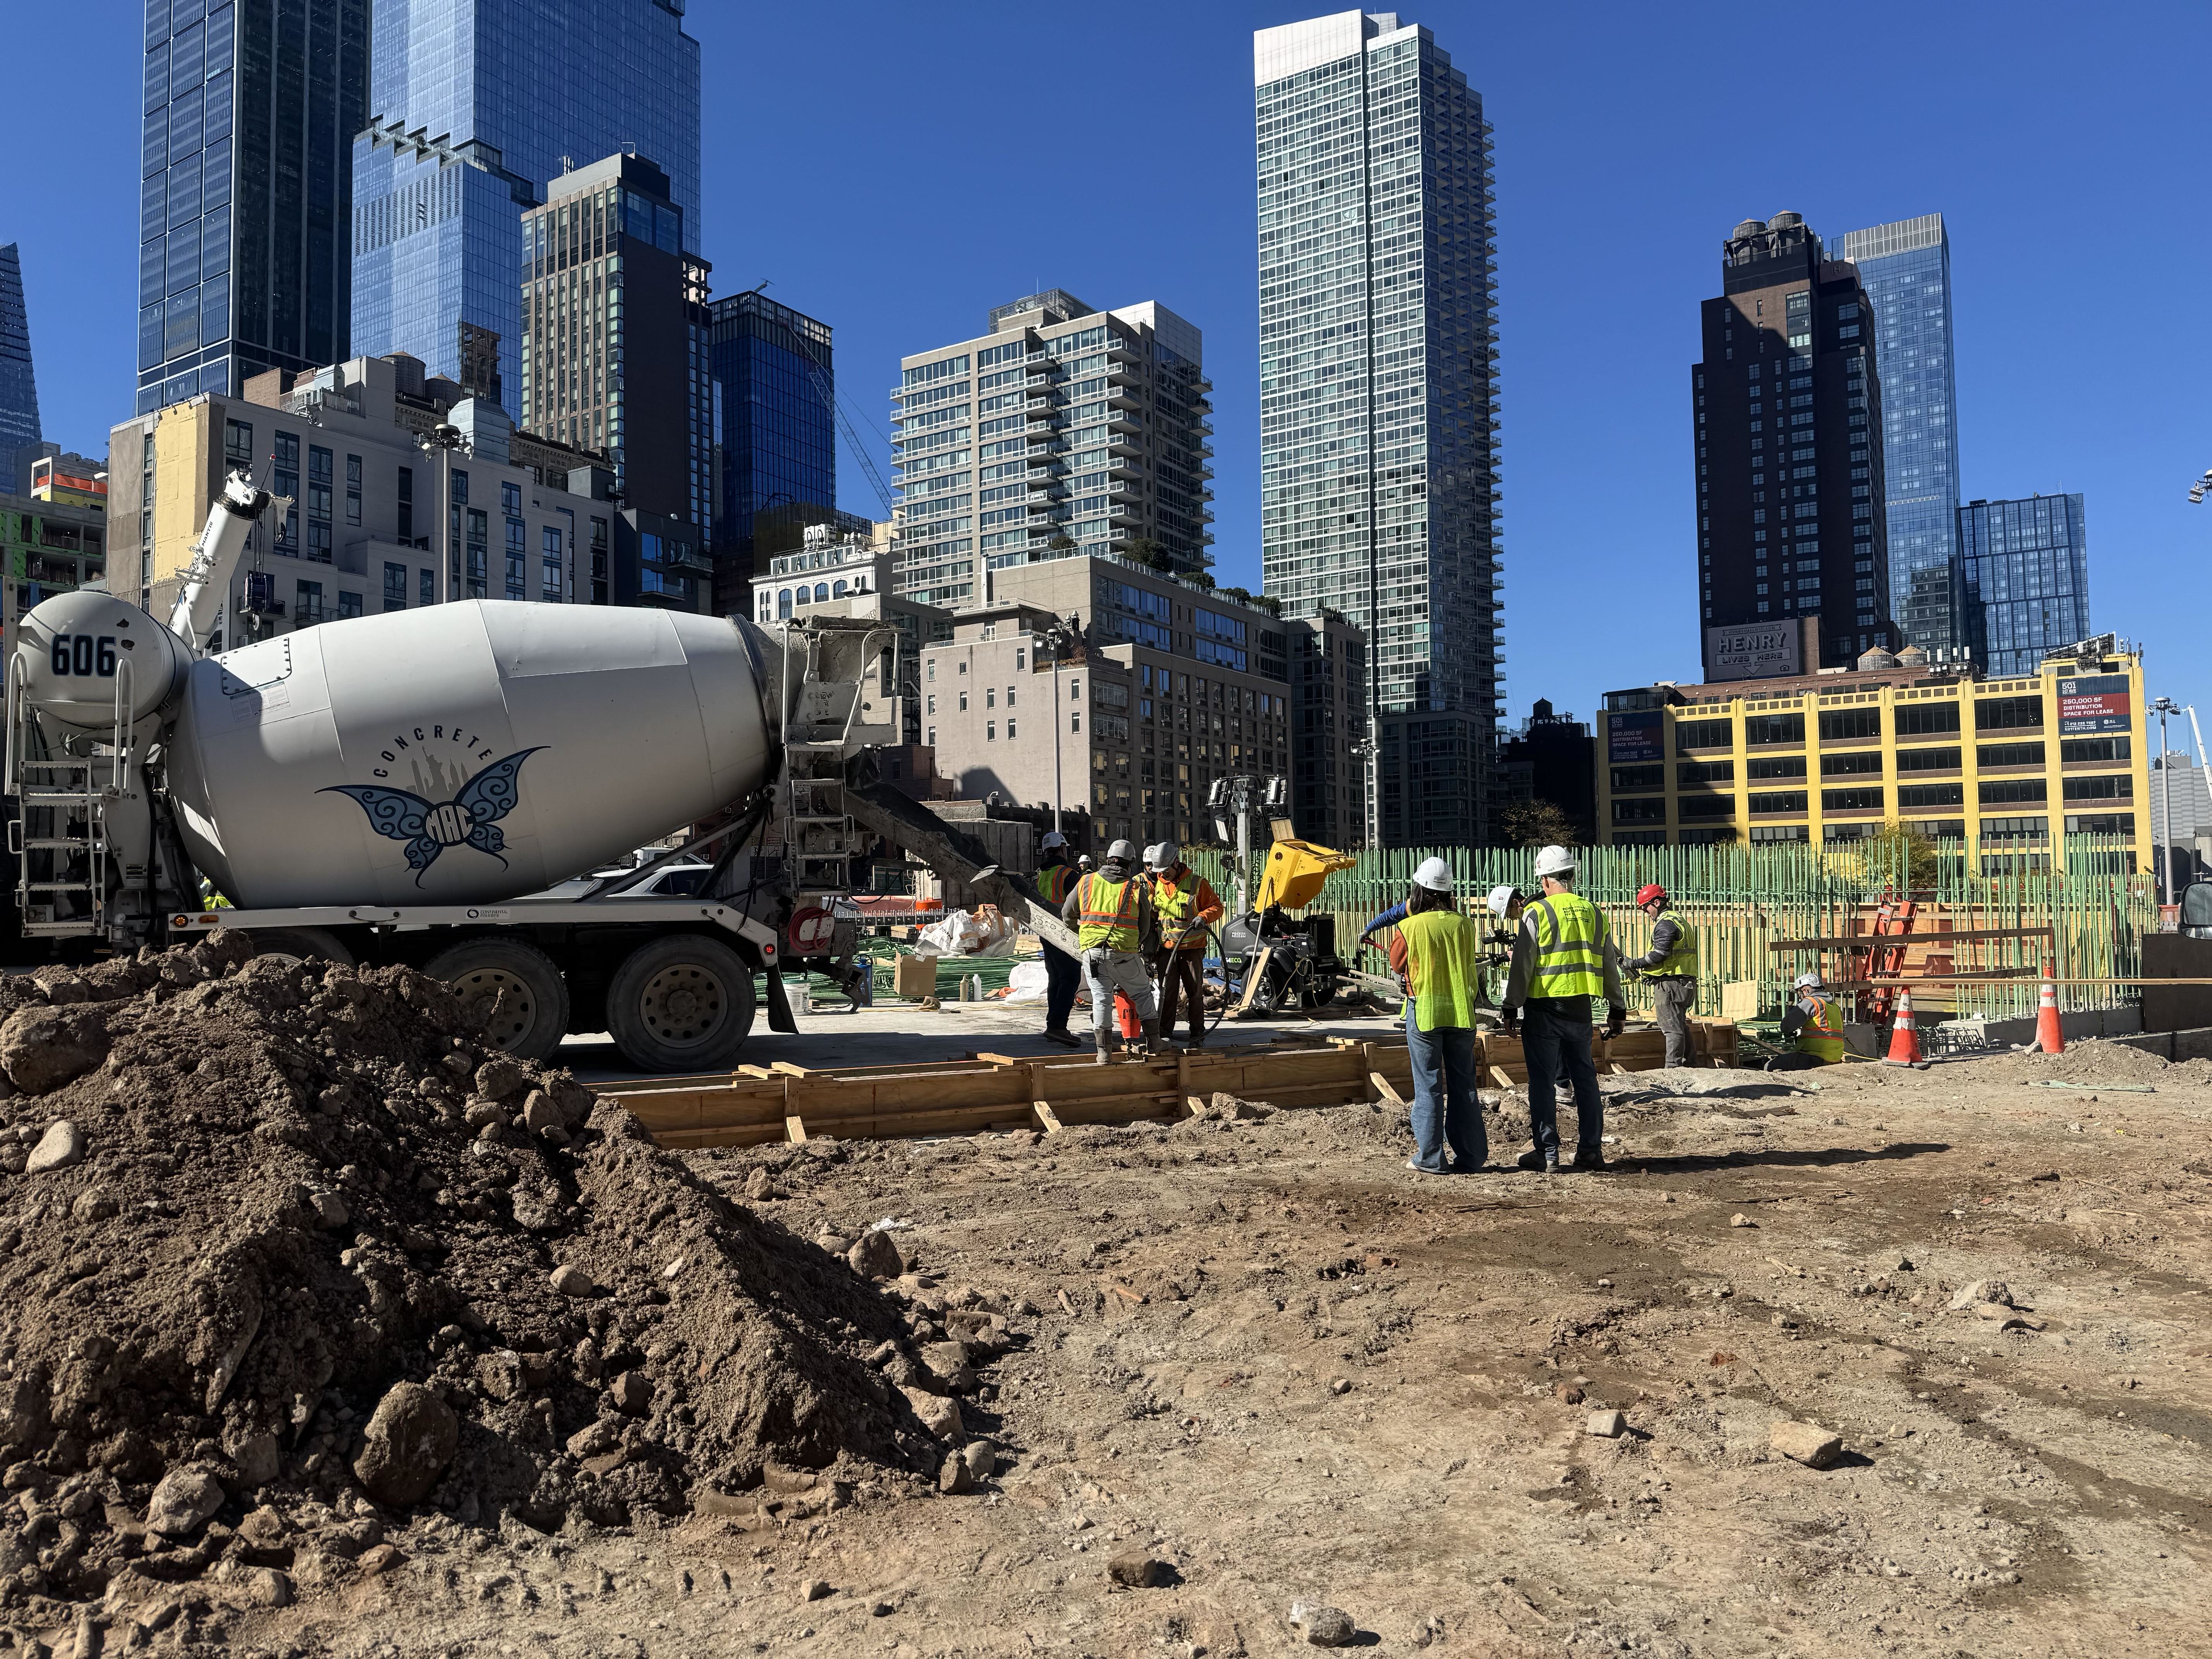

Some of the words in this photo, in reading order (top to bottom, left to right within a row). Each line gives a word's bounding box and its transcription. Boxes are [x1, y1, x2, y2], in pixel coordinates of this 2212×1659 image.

[51, 634, 117, 678] 606
[1718, 632, 1786, 653] HENRY
[1722, 656, 1750, 664] LIVES
[1757, 652, 1783, 661] HERE
[373, 725, 492, 778] CONCRETE
[425, 805, 473, 843] MAC
